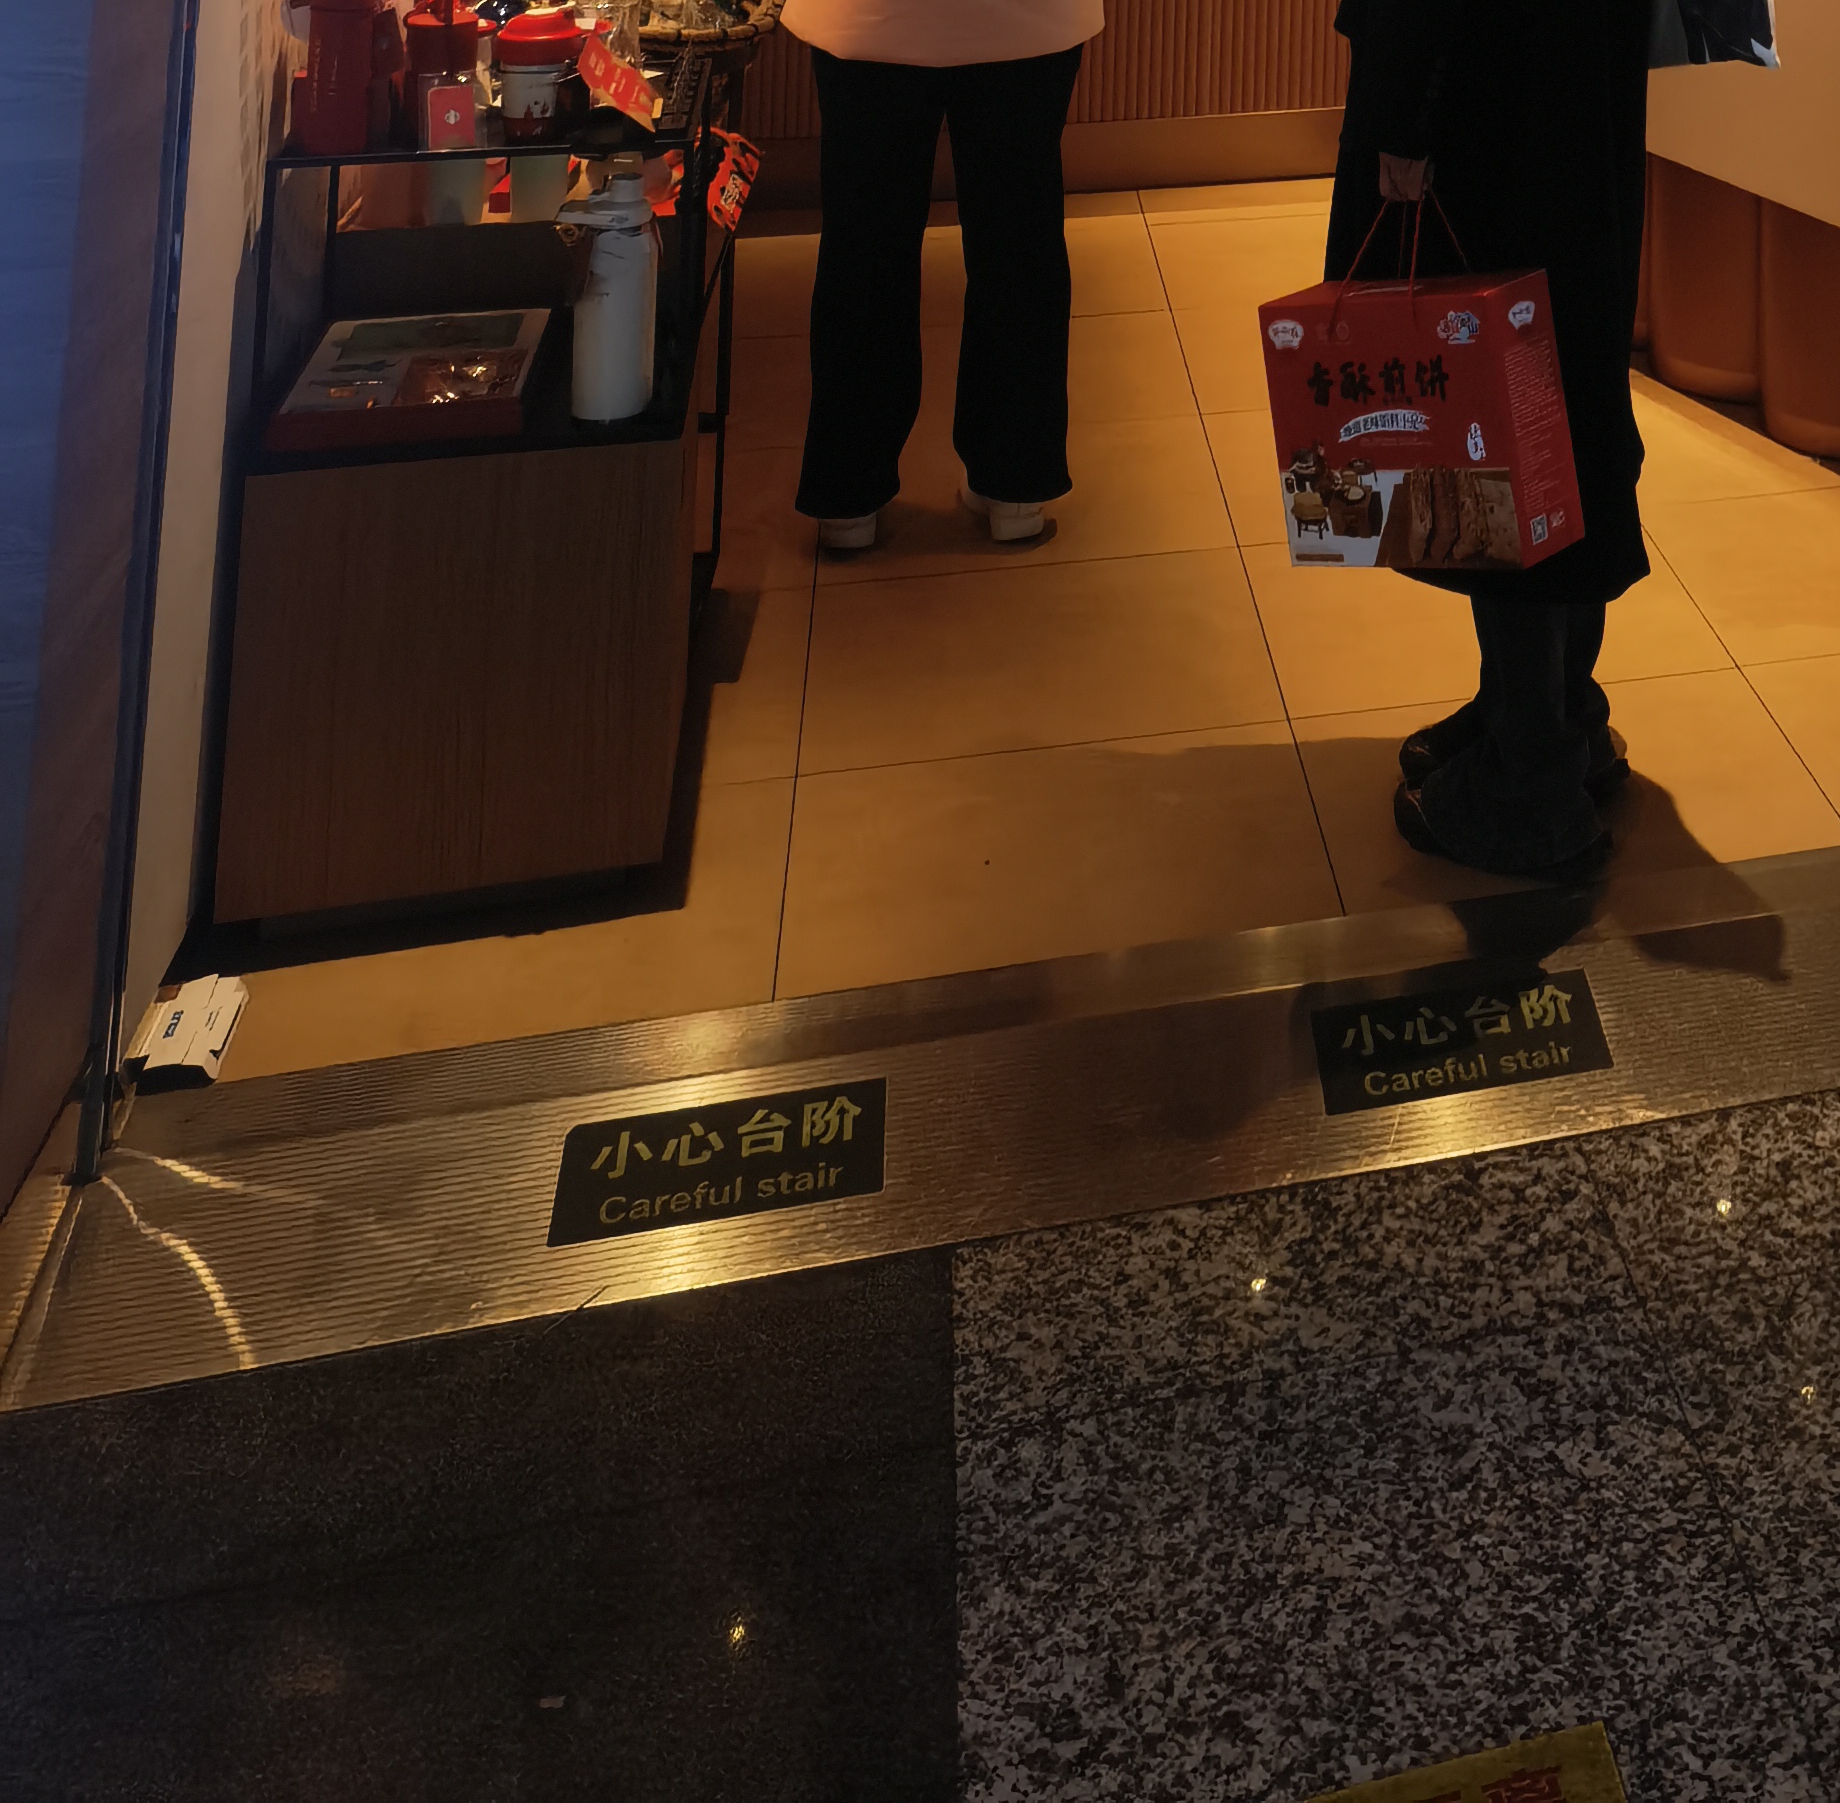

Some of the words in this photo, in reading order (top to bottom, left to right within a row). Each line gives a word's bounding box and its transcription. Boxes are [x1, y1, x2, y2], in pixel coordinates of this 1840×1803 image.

[1341, 983, 1573, 1057] 小心台阶
[1363, 1053, 1488, 1097] Careful
[1499, 1040, 1573, 1075] stair
[589, 1095, 862, 1180] 小心台阶
[599, 1176, 743, 1225] Careful
[757, 1161, 844, 1198] stair
